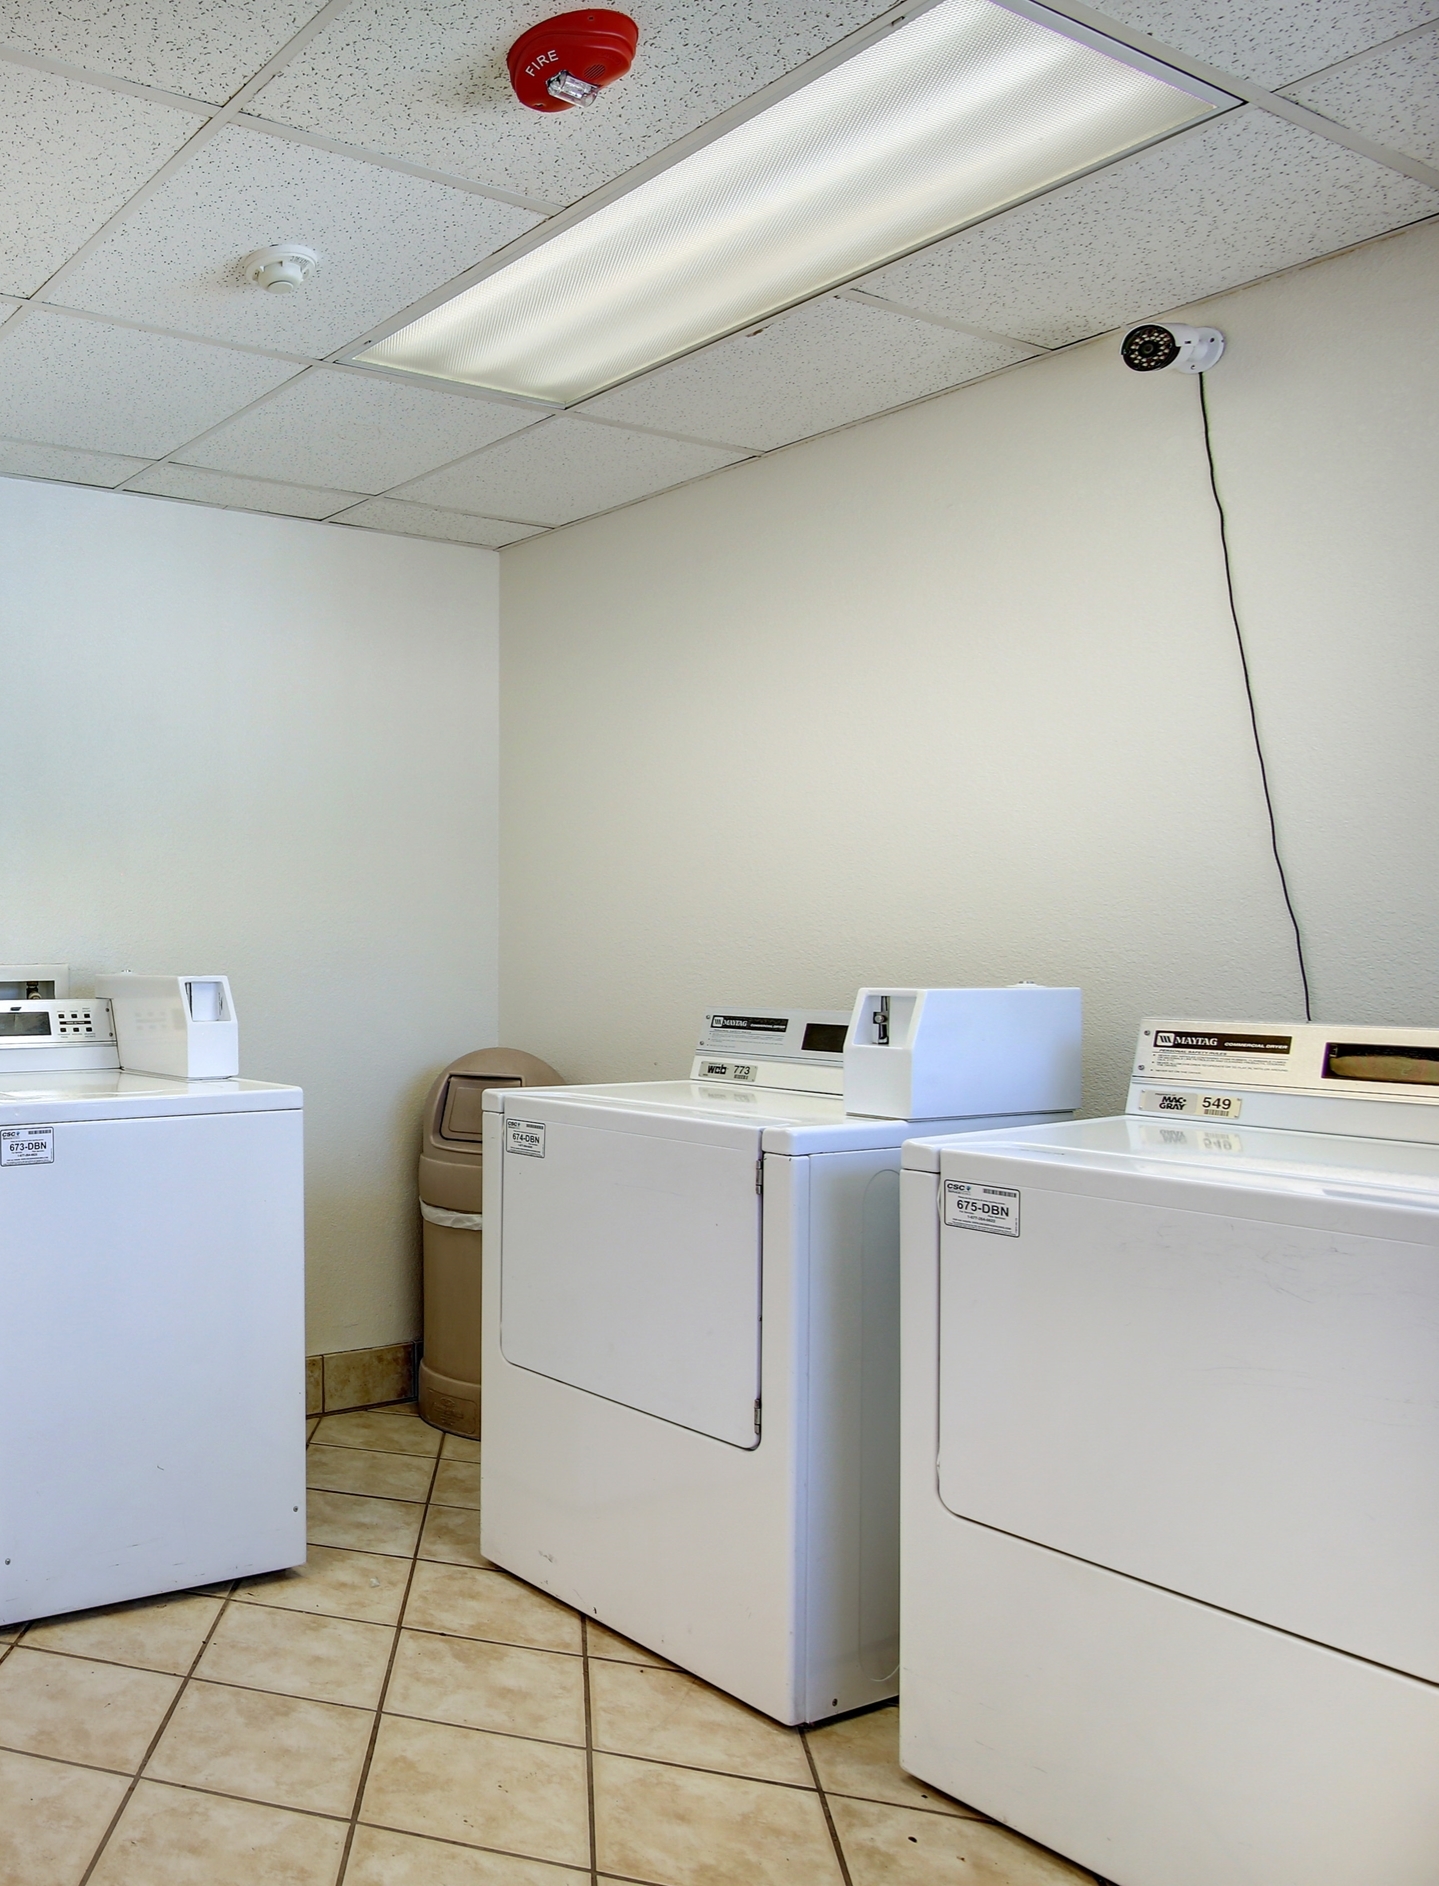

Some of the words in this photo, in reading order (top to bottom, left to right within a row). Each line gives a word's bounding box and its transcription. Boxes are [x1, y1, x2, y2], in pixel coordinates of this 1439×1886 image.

[525, 50, 559, 77] FIRE
[722, 1019, 748, 1027] MAYTAG
[1174, 1036, 1219, 1046] MAYTAG
[734, 1065, 751, 1075] 773
[1202, 1097, 1232, 1110] 549
[512, 1132, 540, 1144] 674-DBN
[9, 1141, 47, 1152] 673-DBN
[947, 1183, 966, 1191] CSC
[956, 1199, 1009, 1217] 675-DBN
